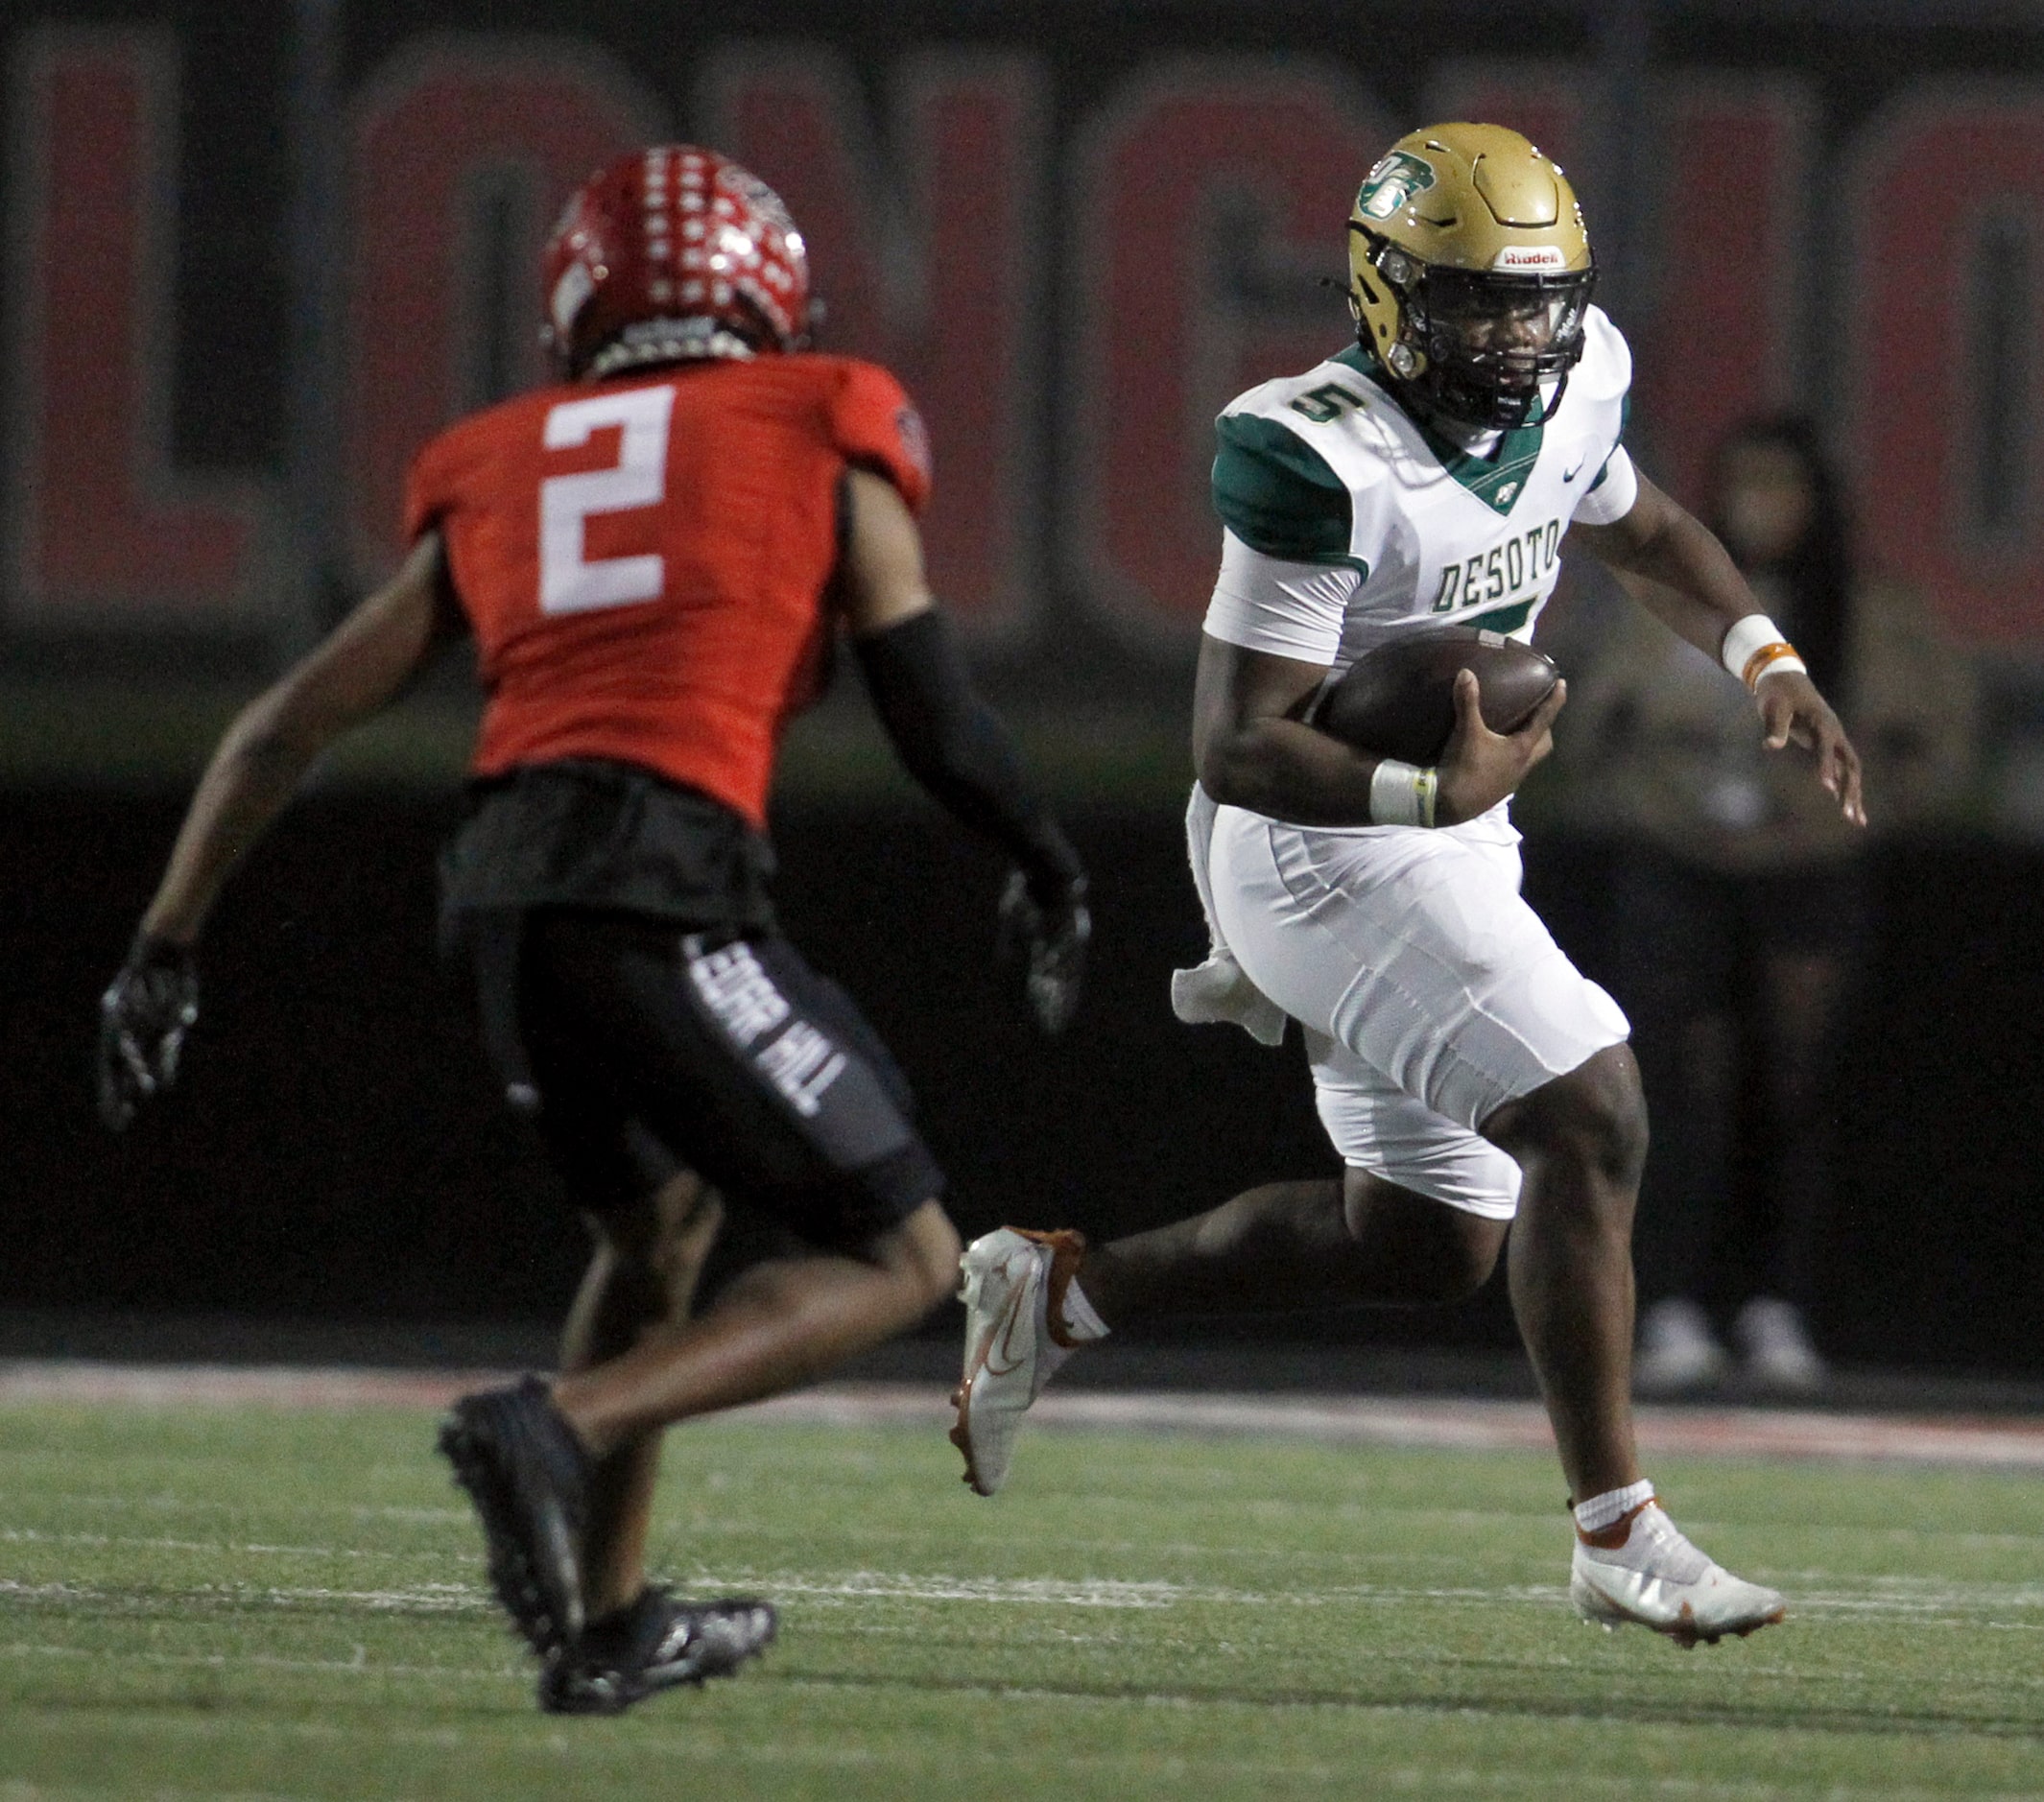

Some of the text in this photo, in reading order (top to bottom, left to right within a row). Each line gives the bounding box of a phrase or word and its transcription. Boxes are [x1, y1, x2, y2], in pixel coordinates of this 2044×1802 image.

[1290, 382, 1367, 424] 5
[541, 384, 676, 615] 2
[1432, 518, 1559, 613] DESOTO
